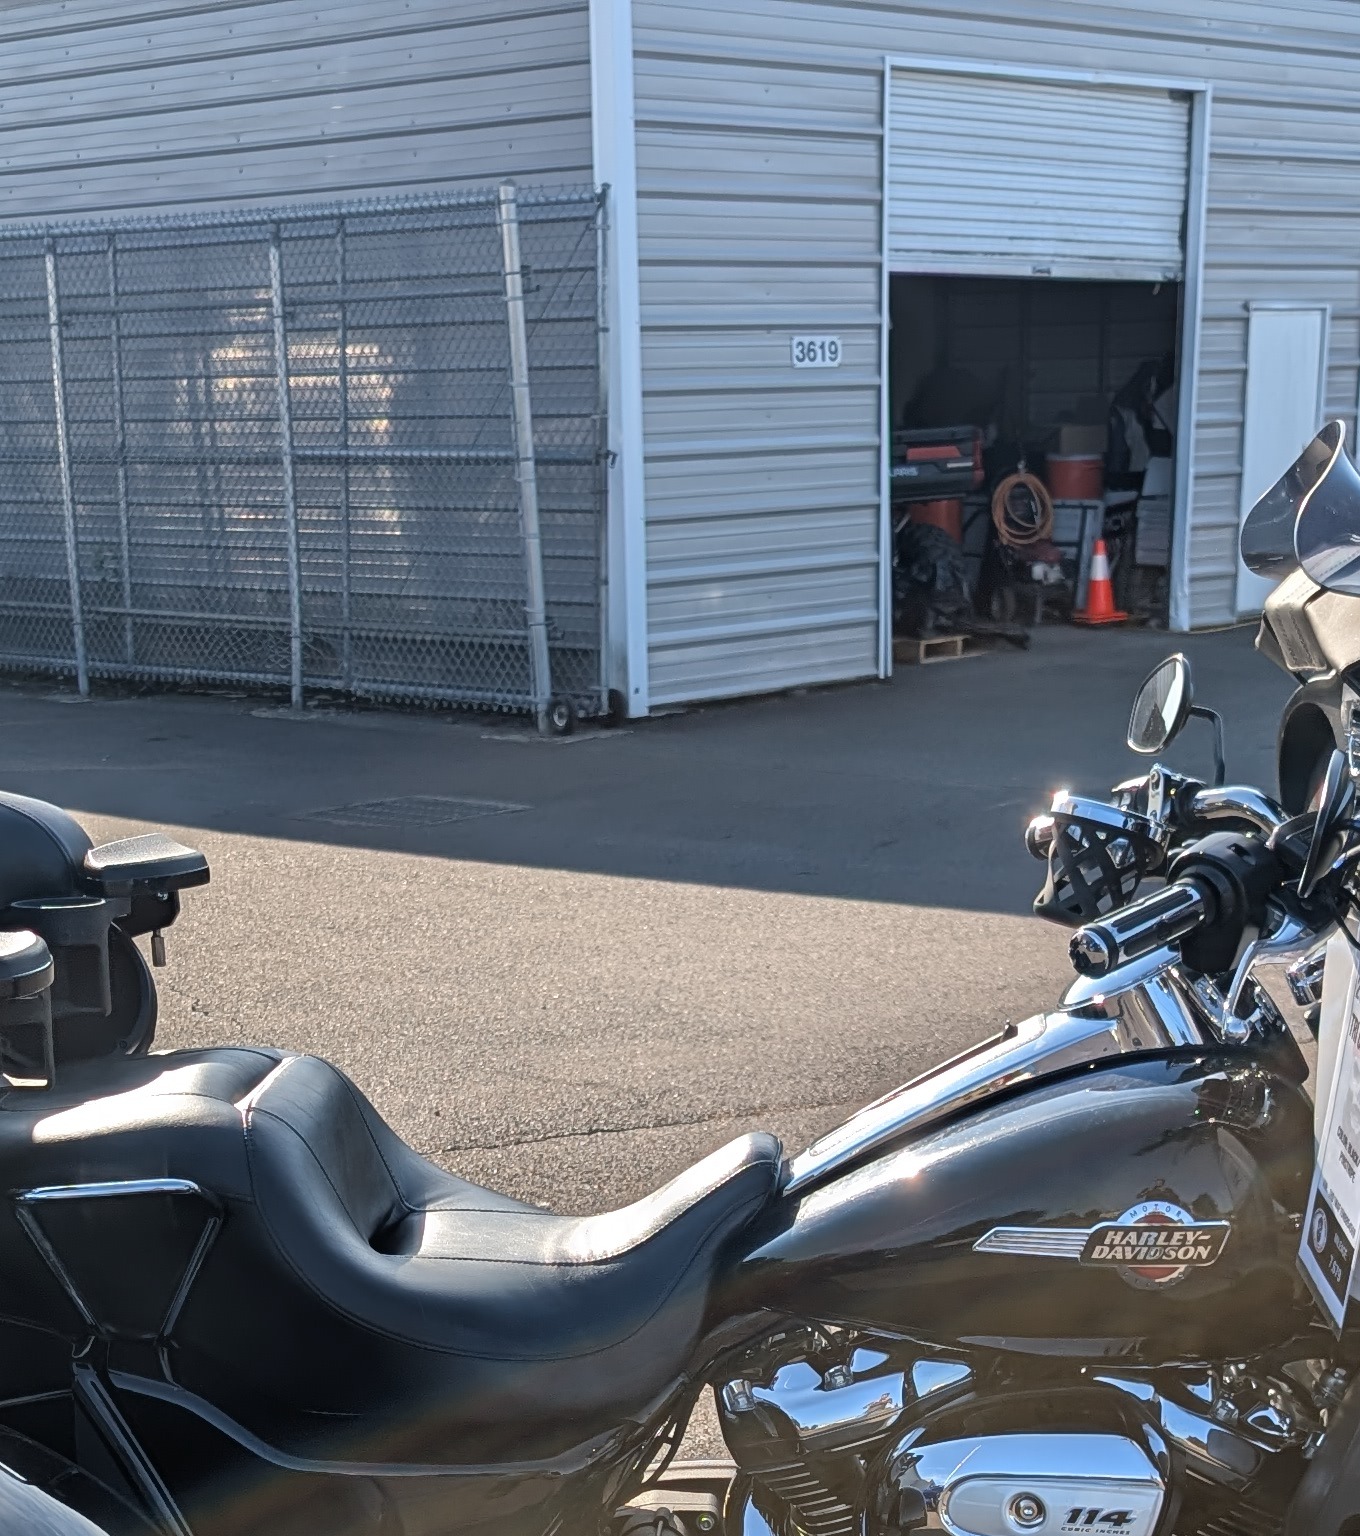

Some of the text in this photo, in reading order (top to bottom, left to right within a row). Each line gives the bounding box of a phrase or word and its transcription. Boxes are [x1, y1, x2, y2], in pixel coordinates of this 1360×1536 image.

[795, 341, 838, 362] 3619
[1130, 1204, 1181, 1218] MOTOR
[1103, 1231, 1211, 1245] HARLEY-
[1091, 1246, 1211, 1260] DAVIDSON
[1063, 1506, 1137, 1529] 114
[1095, 1528, 1130, 1536] INCHES
